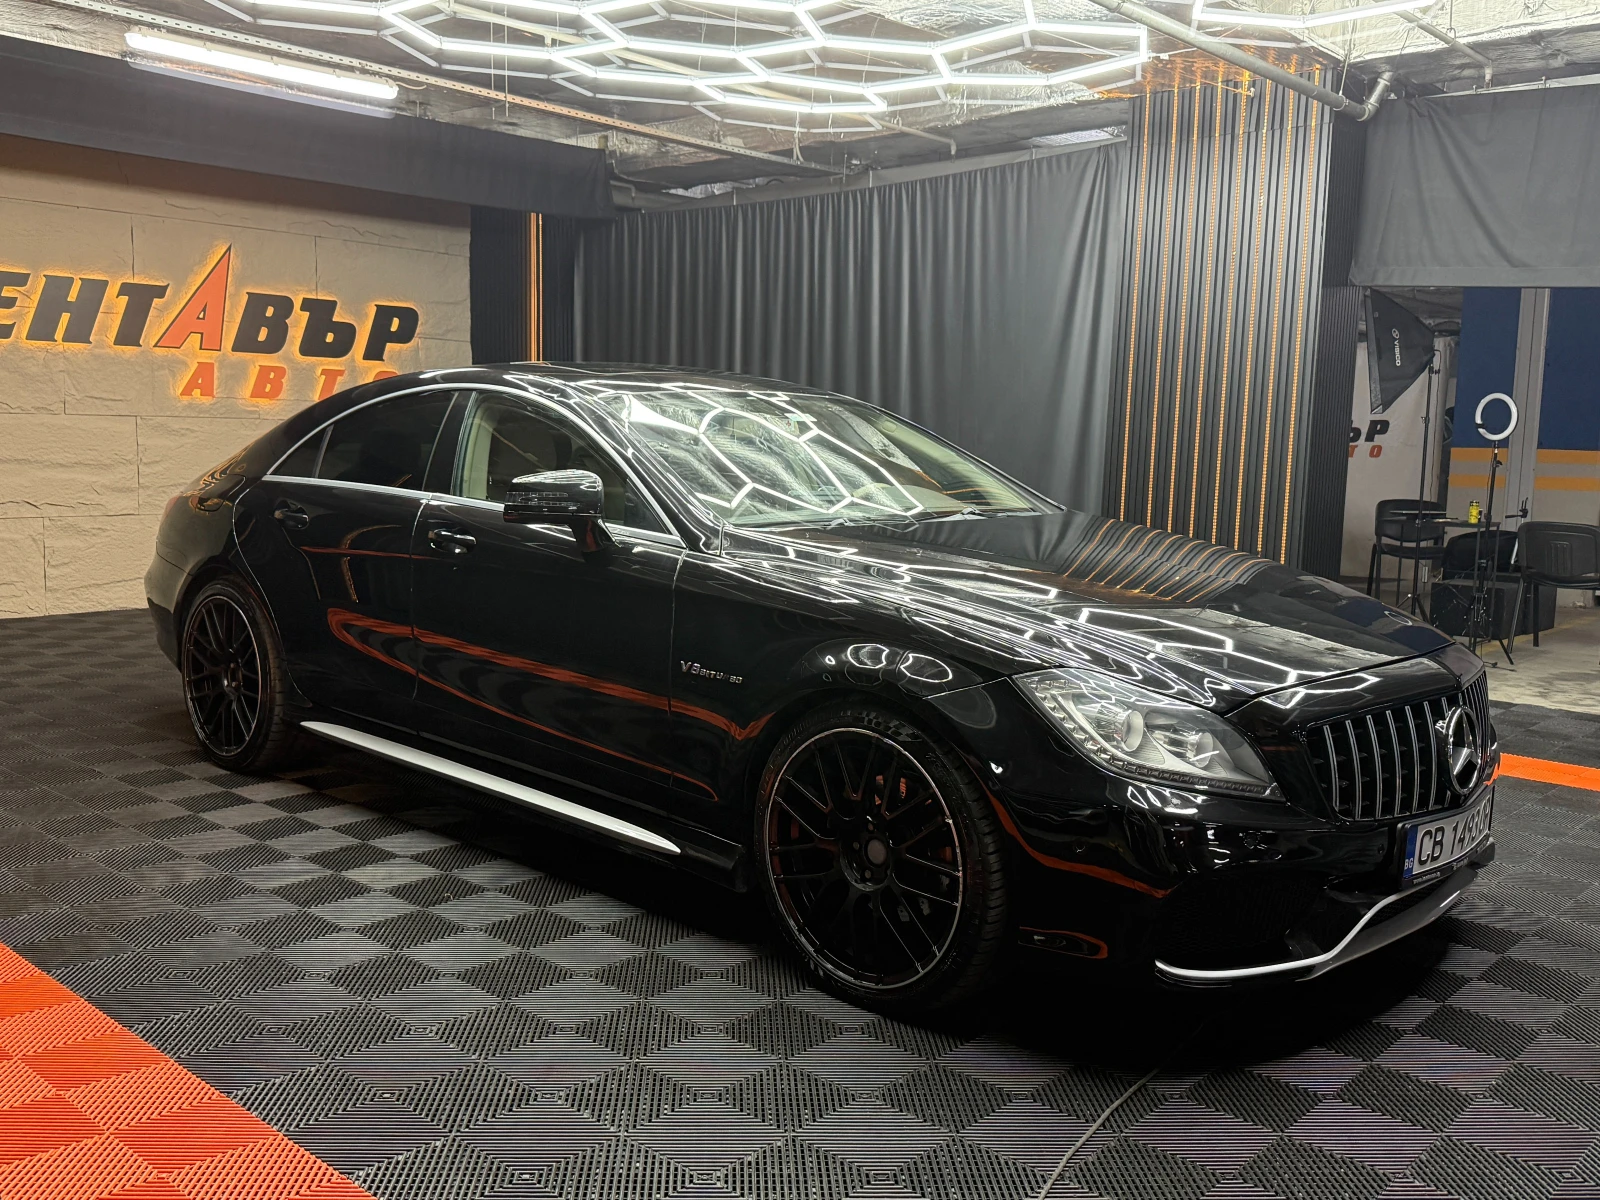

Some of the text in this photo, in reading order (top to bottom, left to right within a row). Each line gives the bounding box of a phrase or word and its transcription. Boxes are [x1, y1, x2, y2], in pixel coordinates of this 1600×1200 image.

[0, 243, 419, 362] НТАВЪР
[1393, 339, 1402, 367] VISICO
[179, 361, 399, 401] АВТ
[1404, 858, 1414, 870] BG
